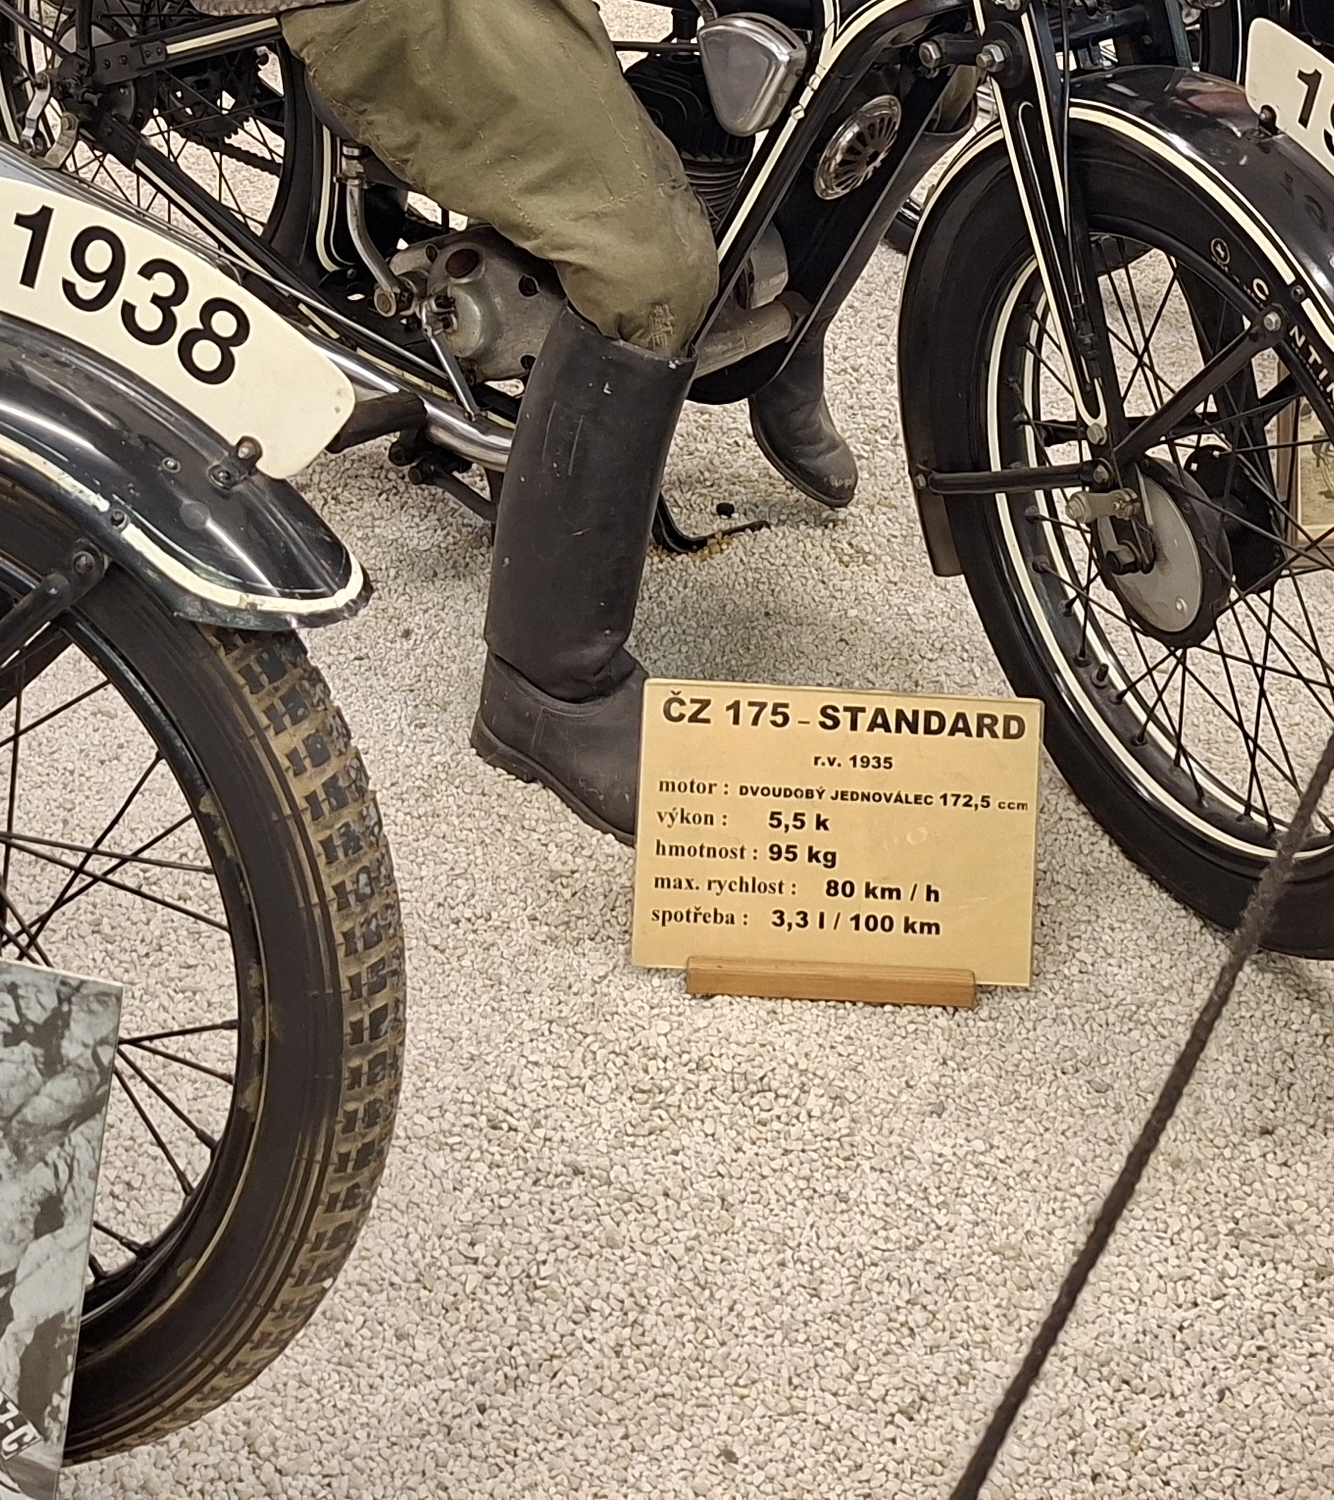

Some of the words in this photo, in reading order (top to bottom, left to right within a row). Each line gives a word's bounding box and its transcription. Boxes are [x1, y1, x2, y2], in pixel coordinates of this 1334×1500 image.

[11, 204, 252, 388] 1938
[661, 689, 712, 726] ČZ
[724, 699, 791, 729] 175
[818, 703, 1027, 742] STANDARD
[812, 753, 842, 769] r.v.
[848, 754, 894, 771] 1935
[657, 778, 718, 797] motor
[738, 782, 827, 801] DVOUDOBÝ
[829, 786, 935, 808] JEDNOVÁLEC
[938, 792, 992, 813] 172,5
[997, 799, 1029, 812] ccm
[655, 808, 716, 831] výkon
[767, 812, 809, 834] 5,5
[814, 812, 831, 832] k
[654, 840, 748, 862] hmotnost
[767, 844, 799, 864] 95
[806, 846, 838, 869] kg
[652, 877, 701, 893] max.
[706, 874, 786, 897] rychlost
[824, 879, 855, 899] 80
[864, 880, 903, 901] km
[925, 884, 940, 903] h
[650, 905, 737, 929] spotřeba
[770, 909, 809, 932] 3,3
[849, 914, 895, 935] 100
[903, 916, 942, 937] km
